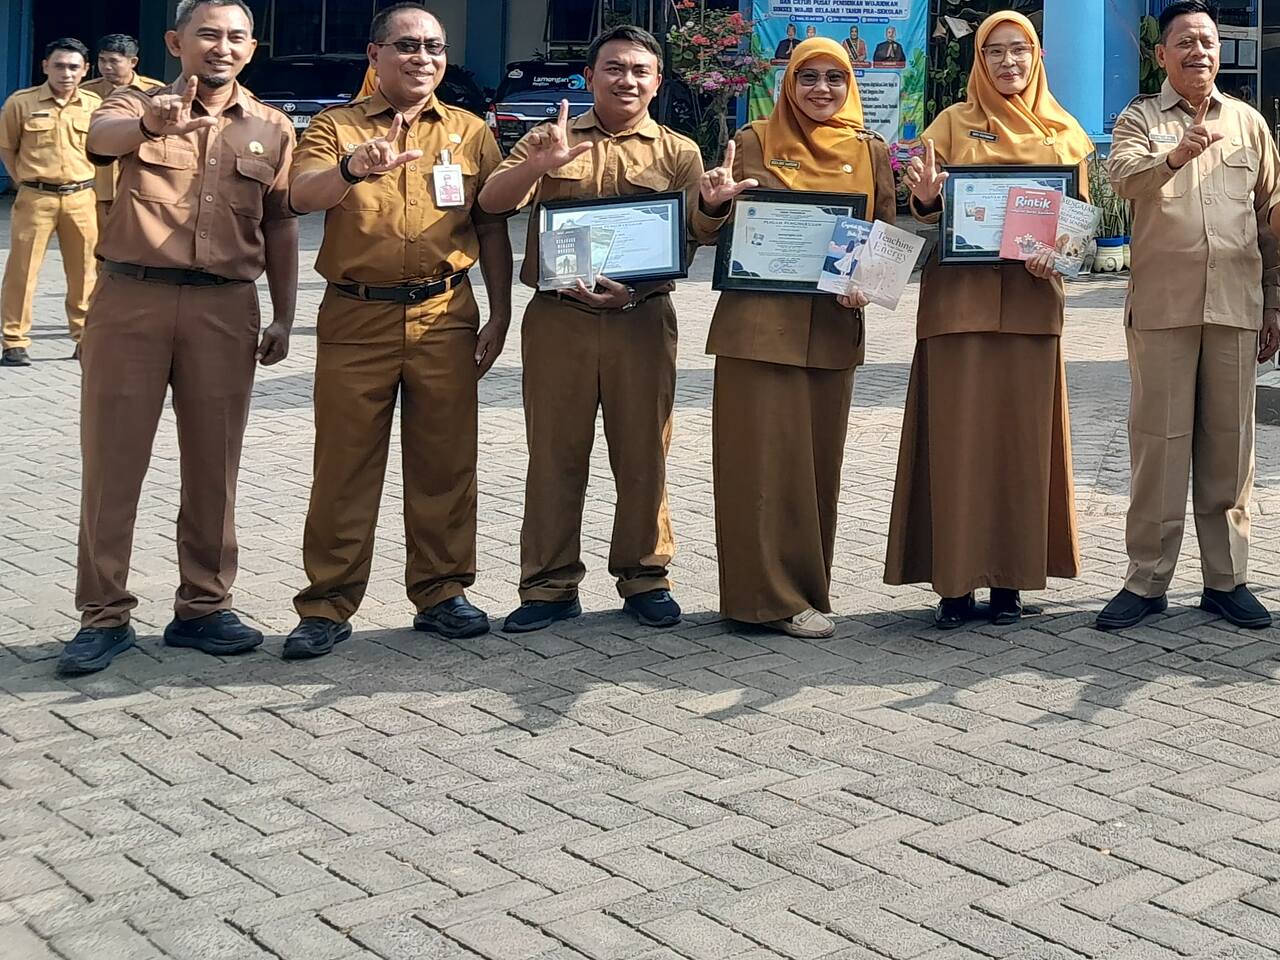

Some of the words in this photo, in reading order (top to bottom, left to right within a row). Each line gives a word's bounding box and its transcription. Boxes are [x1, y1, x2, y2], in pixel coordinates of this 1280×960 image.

[1015, 195, 1052, 209] Rintik
[873, 241, 906, 261] Energy
[878, 231, 914, 253] Teaching
